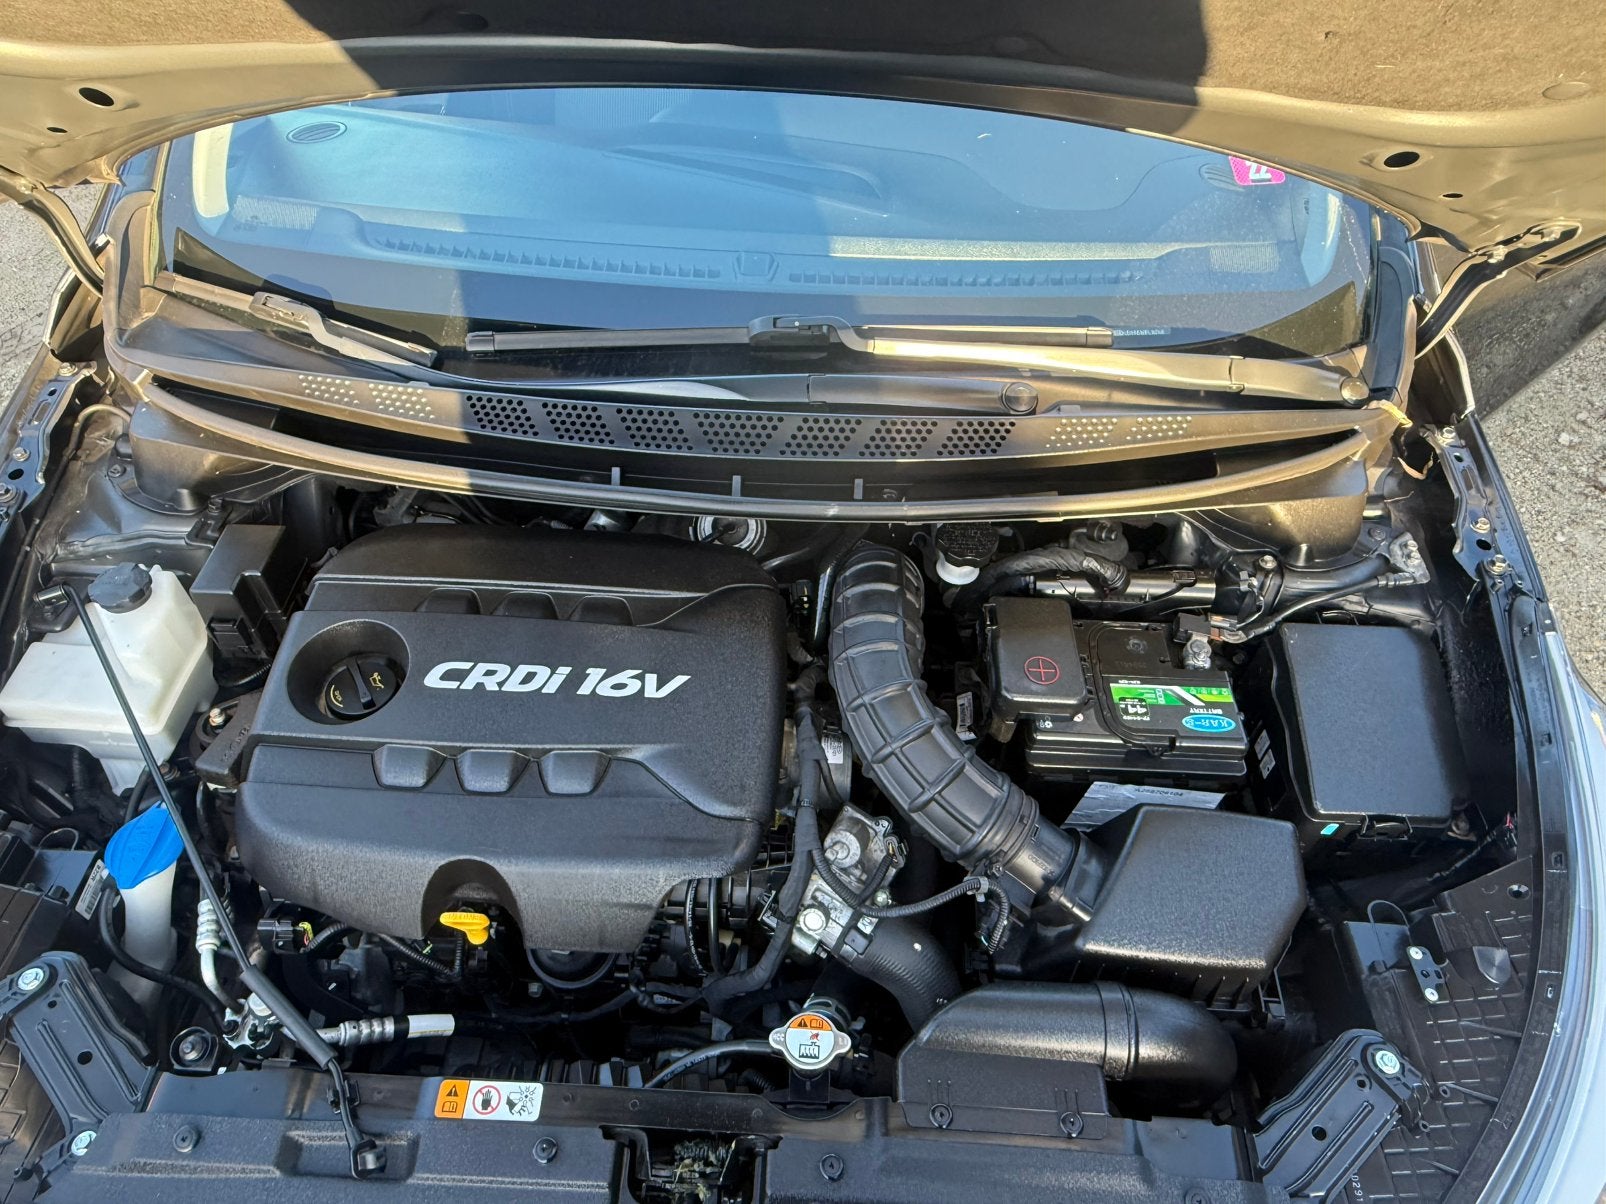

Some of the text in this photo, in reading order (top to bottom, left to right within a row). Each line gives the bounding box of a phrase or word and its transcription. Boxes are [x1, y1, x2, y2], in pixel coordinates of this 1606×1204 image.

[423, 661, 691, 698] CRDi 16V
[1189, 707, 1223, 715] BATTERY
